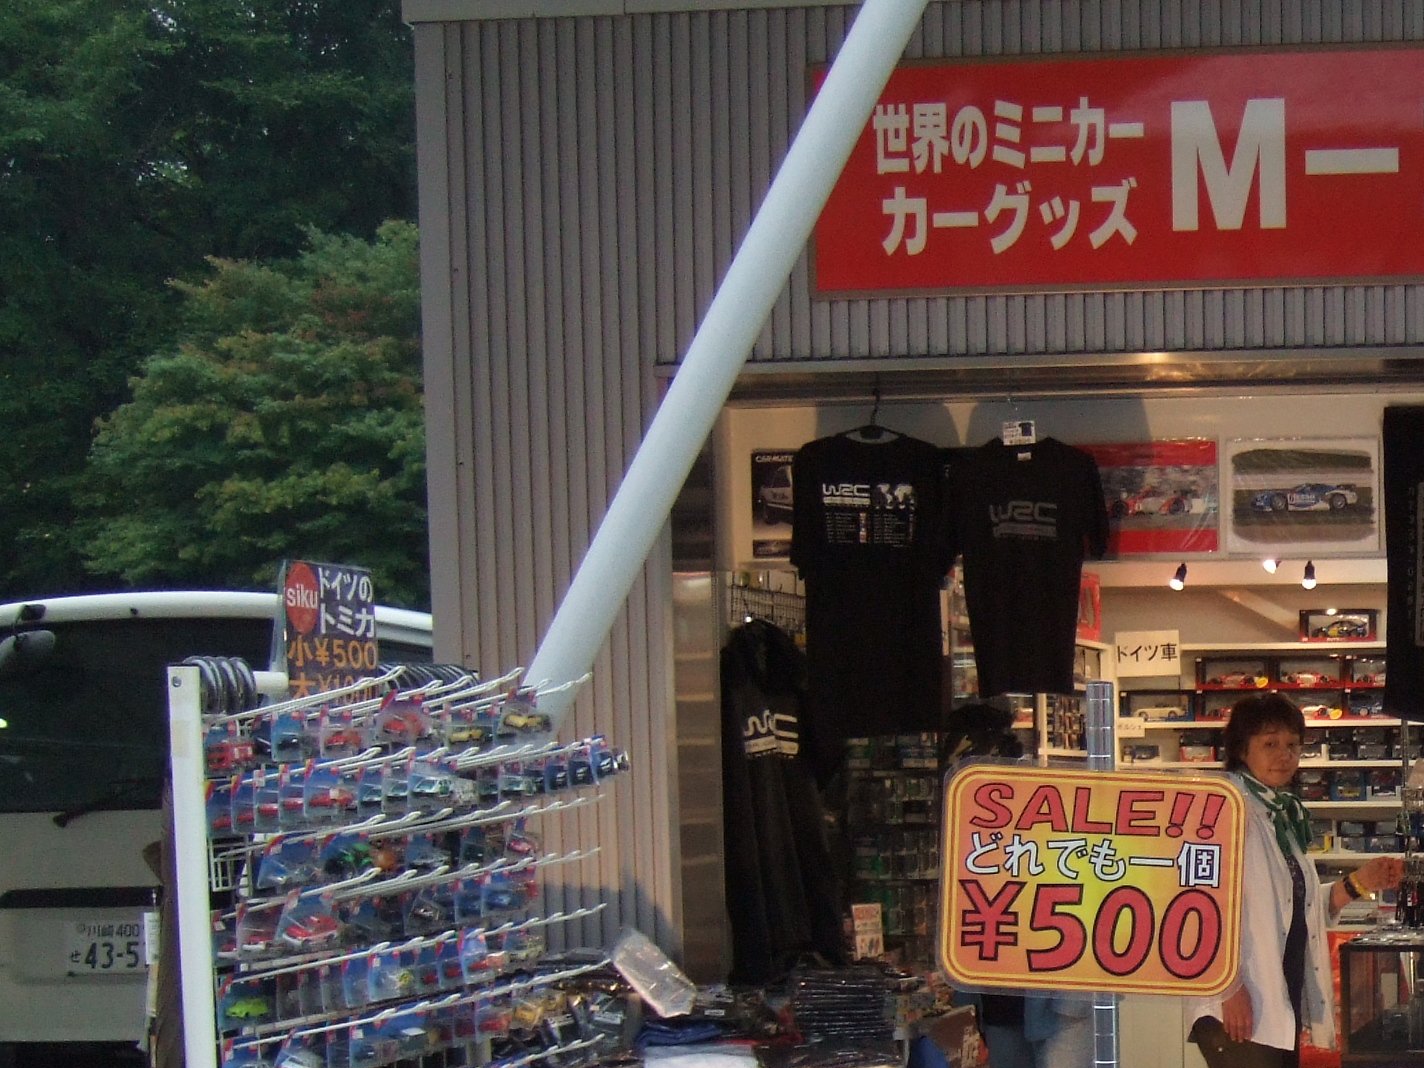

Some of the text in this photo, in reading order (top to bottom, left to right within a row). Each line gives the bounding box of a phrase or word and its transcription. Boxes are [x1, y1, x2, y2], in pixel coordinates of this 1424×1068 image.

[874, 97, 1144, 175] 世界のミニカー
[881, 177, 1138, 256] カーグッズ
[286, 584, 319, 609] siku
[318, 567, 374, 602] ドイツの
[320, 603, 376, 638] トミカ
[1116, 642, 1178, 663] ドイツ車
[969, 782, 1227, 841] SALE!!
[965, 832, 1221, 890] どれでも一個
[958, 878, 1224, 981] ¥500
[85, 941, 148, 969] 43-5
